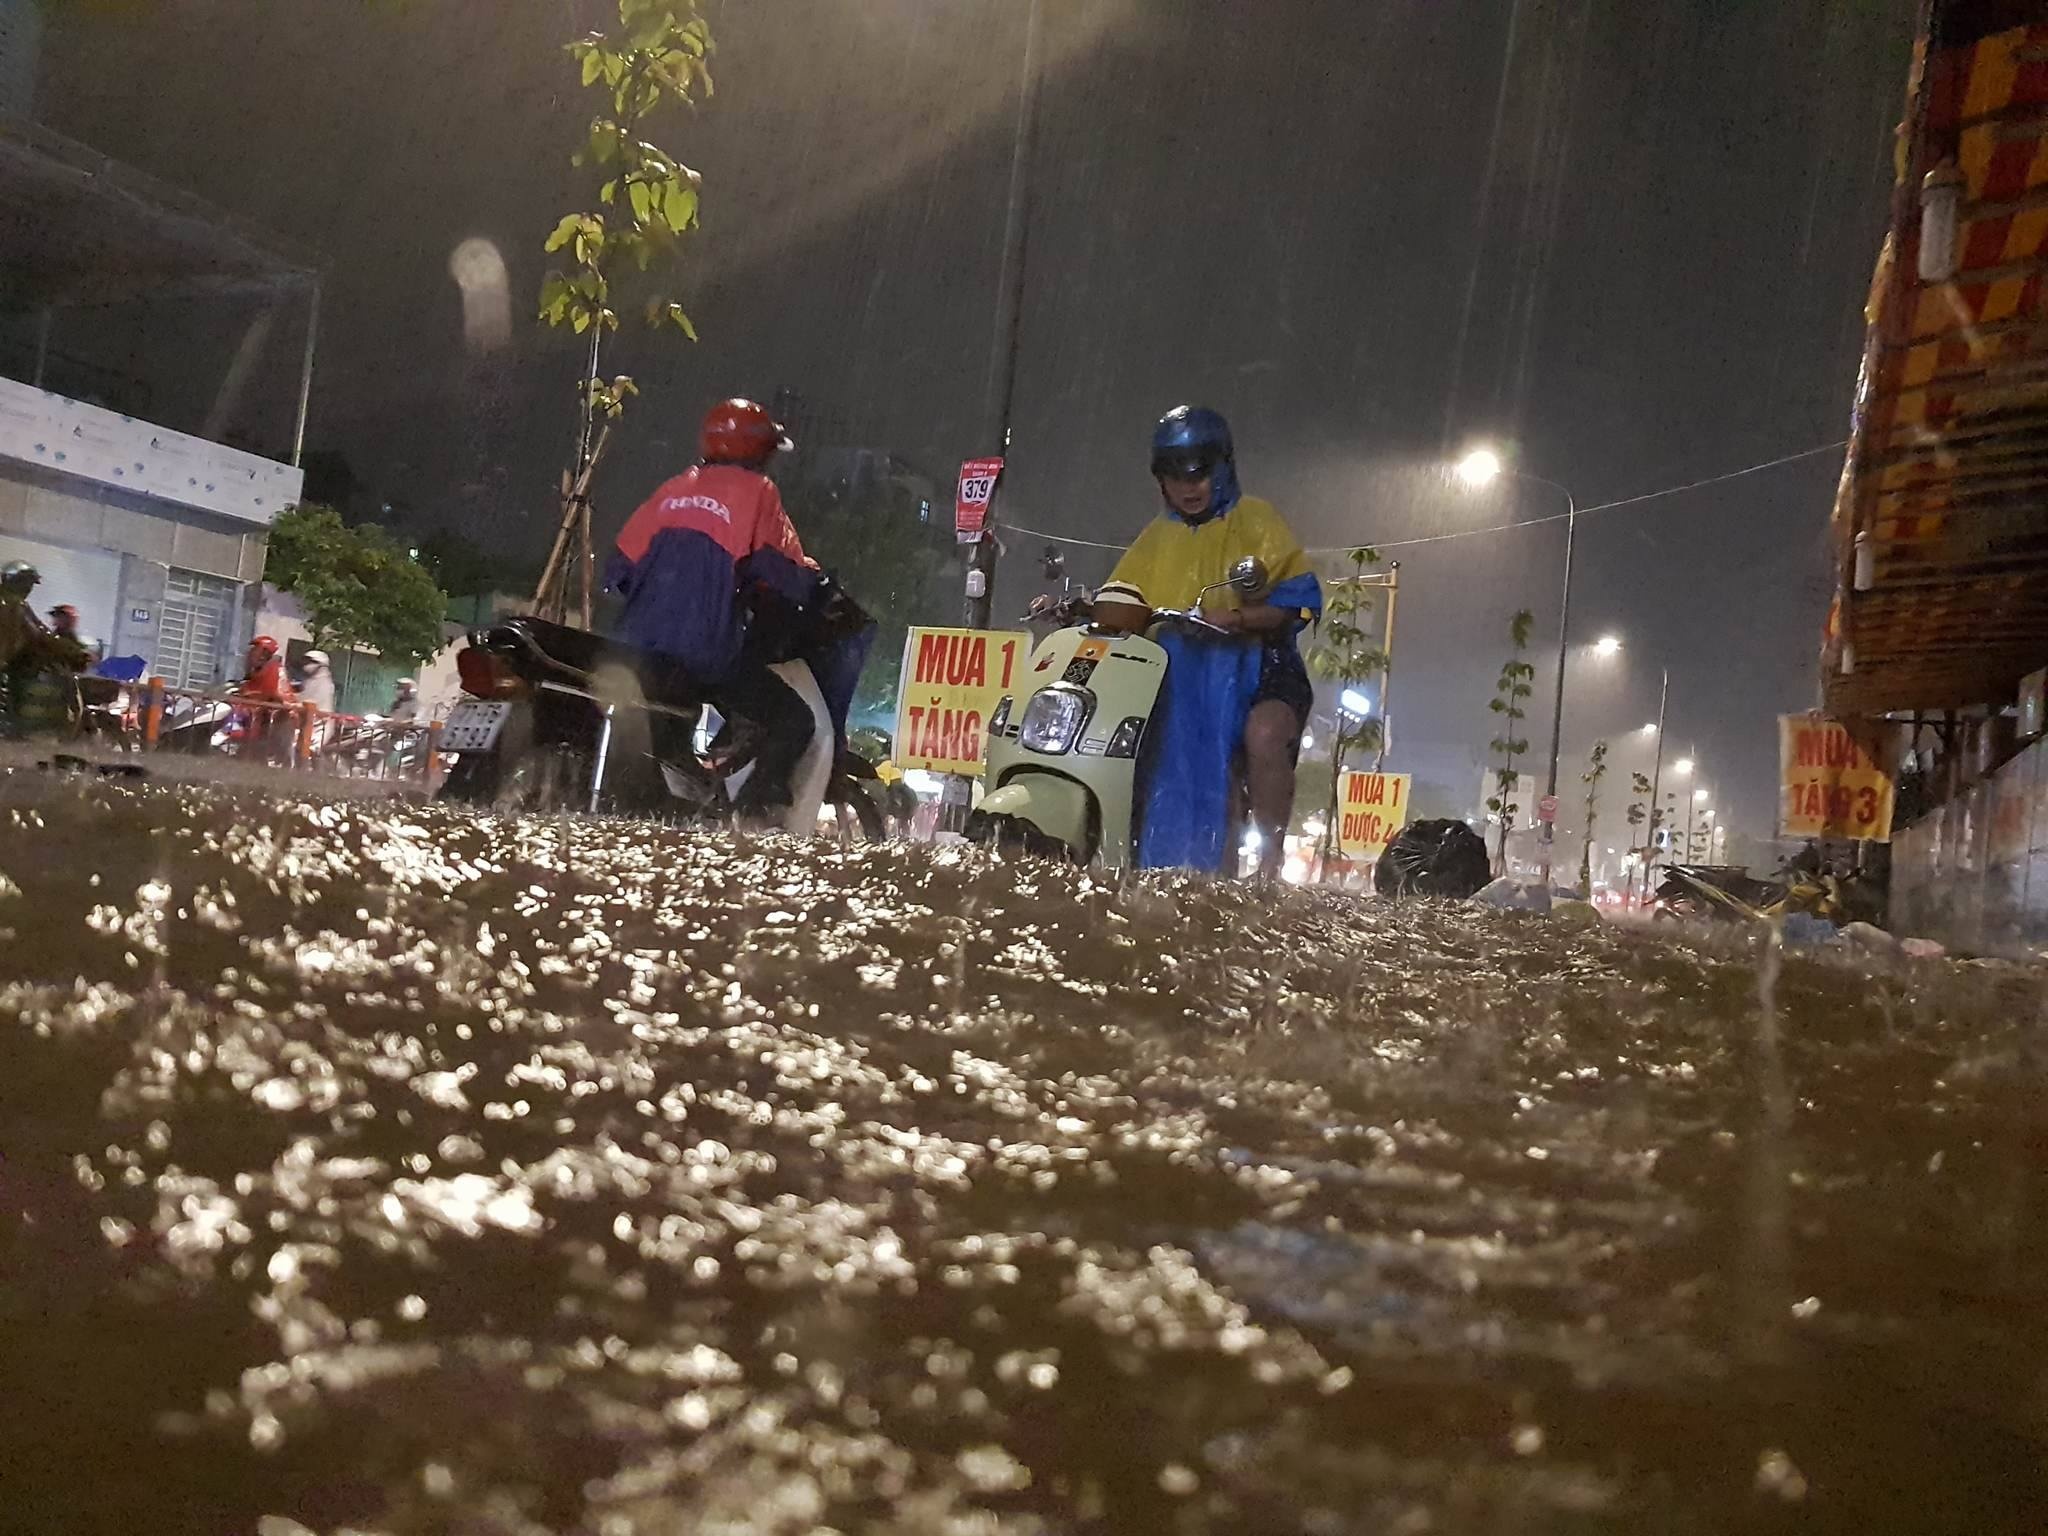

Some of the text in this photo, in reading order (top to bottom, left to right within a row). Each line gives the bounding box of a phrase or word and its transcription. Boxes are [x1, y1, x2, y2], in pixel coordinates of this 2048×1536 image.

[965, 479, 989, 499] 379
[915, 634, 1016, 689] MUA 1
[1797, 729, 1859, 769] MUA
[1347, 773, 1401, 807] MUA 1
[1856, 786, 1878, 824] 3
